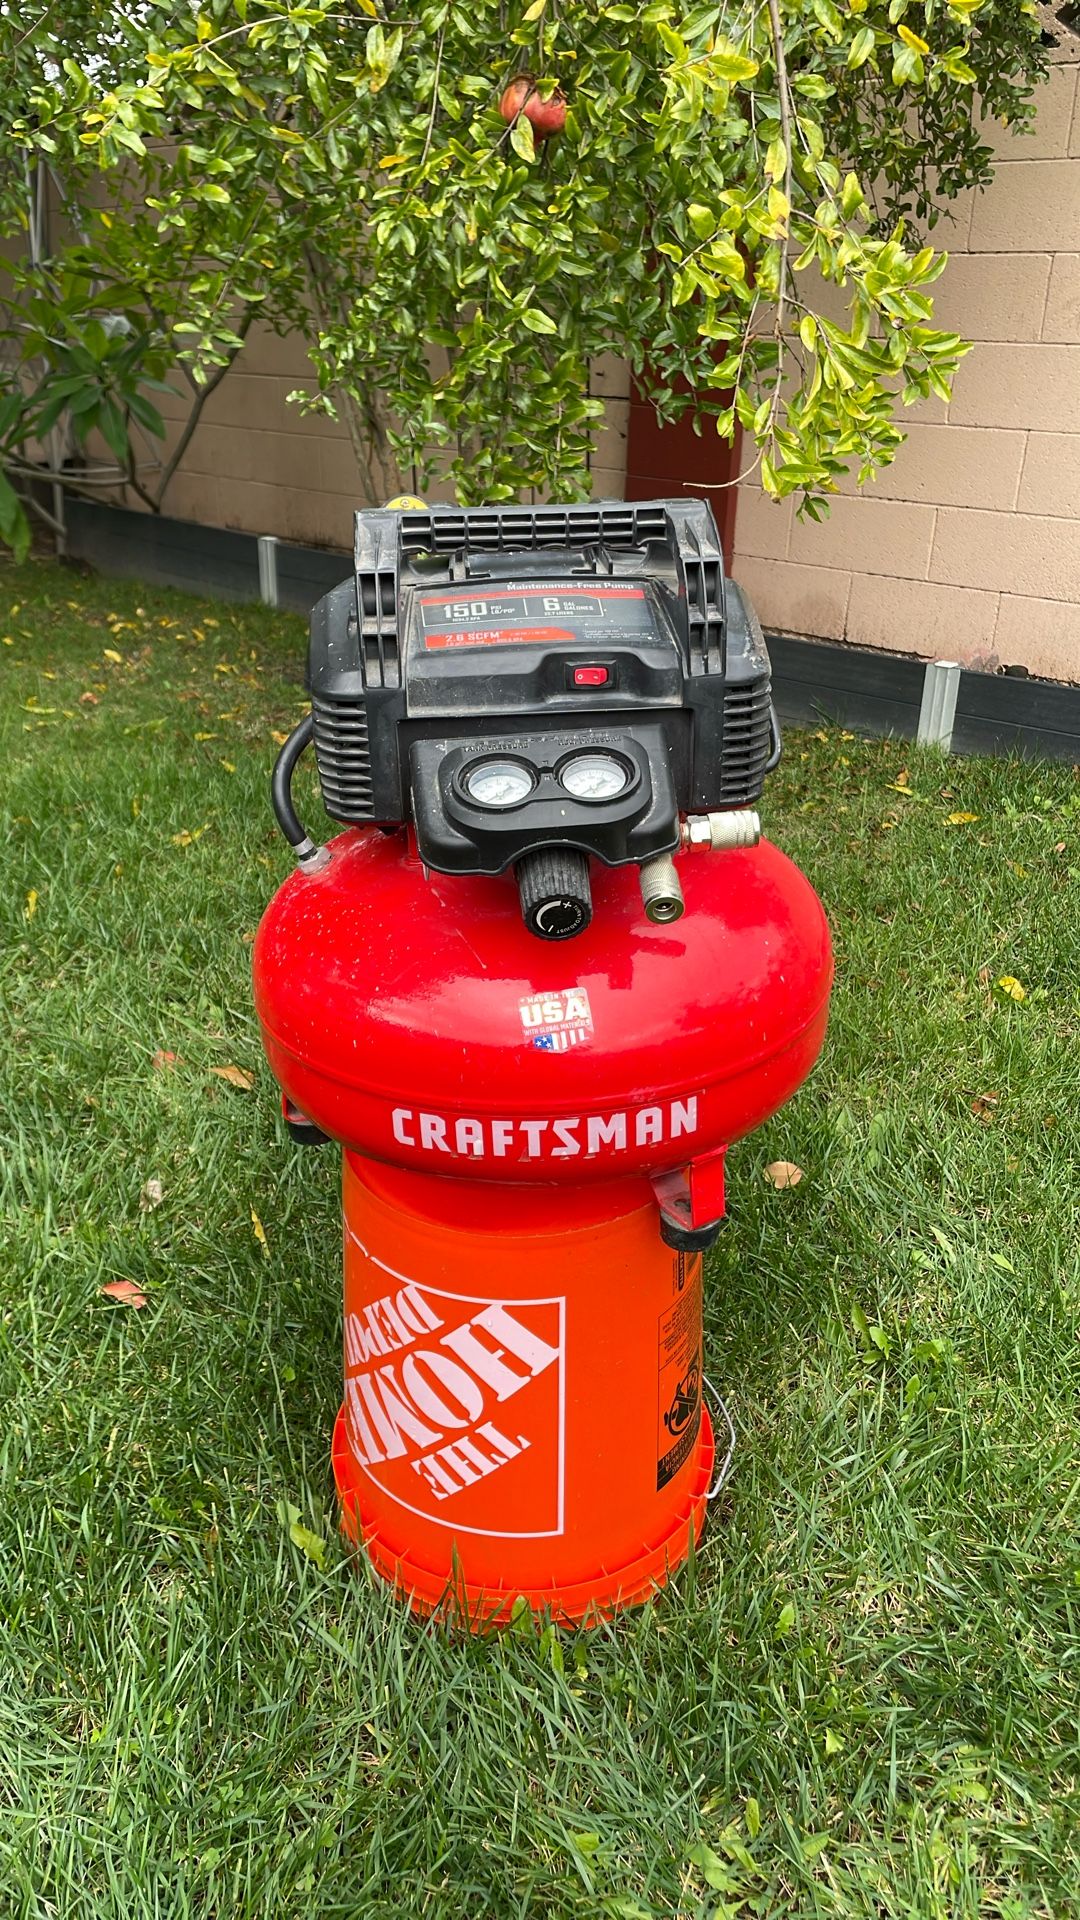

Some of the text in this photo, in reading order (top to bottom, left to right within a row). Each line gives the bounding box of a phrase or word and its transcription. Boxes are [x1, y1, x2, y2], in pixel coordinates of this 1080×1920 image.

[507, 582, 634, 591] Maintenance-Free Pump
[443, 602, 488, 618] 150
[543, 597, 561, 611] 6
[520, 997, 589, 1028] USA
[391, 1096, 698, 1157] CRAFTSMAN
[345, 1303, 560, 1466] HOME
[410, 1421, 533, 1501] THE
